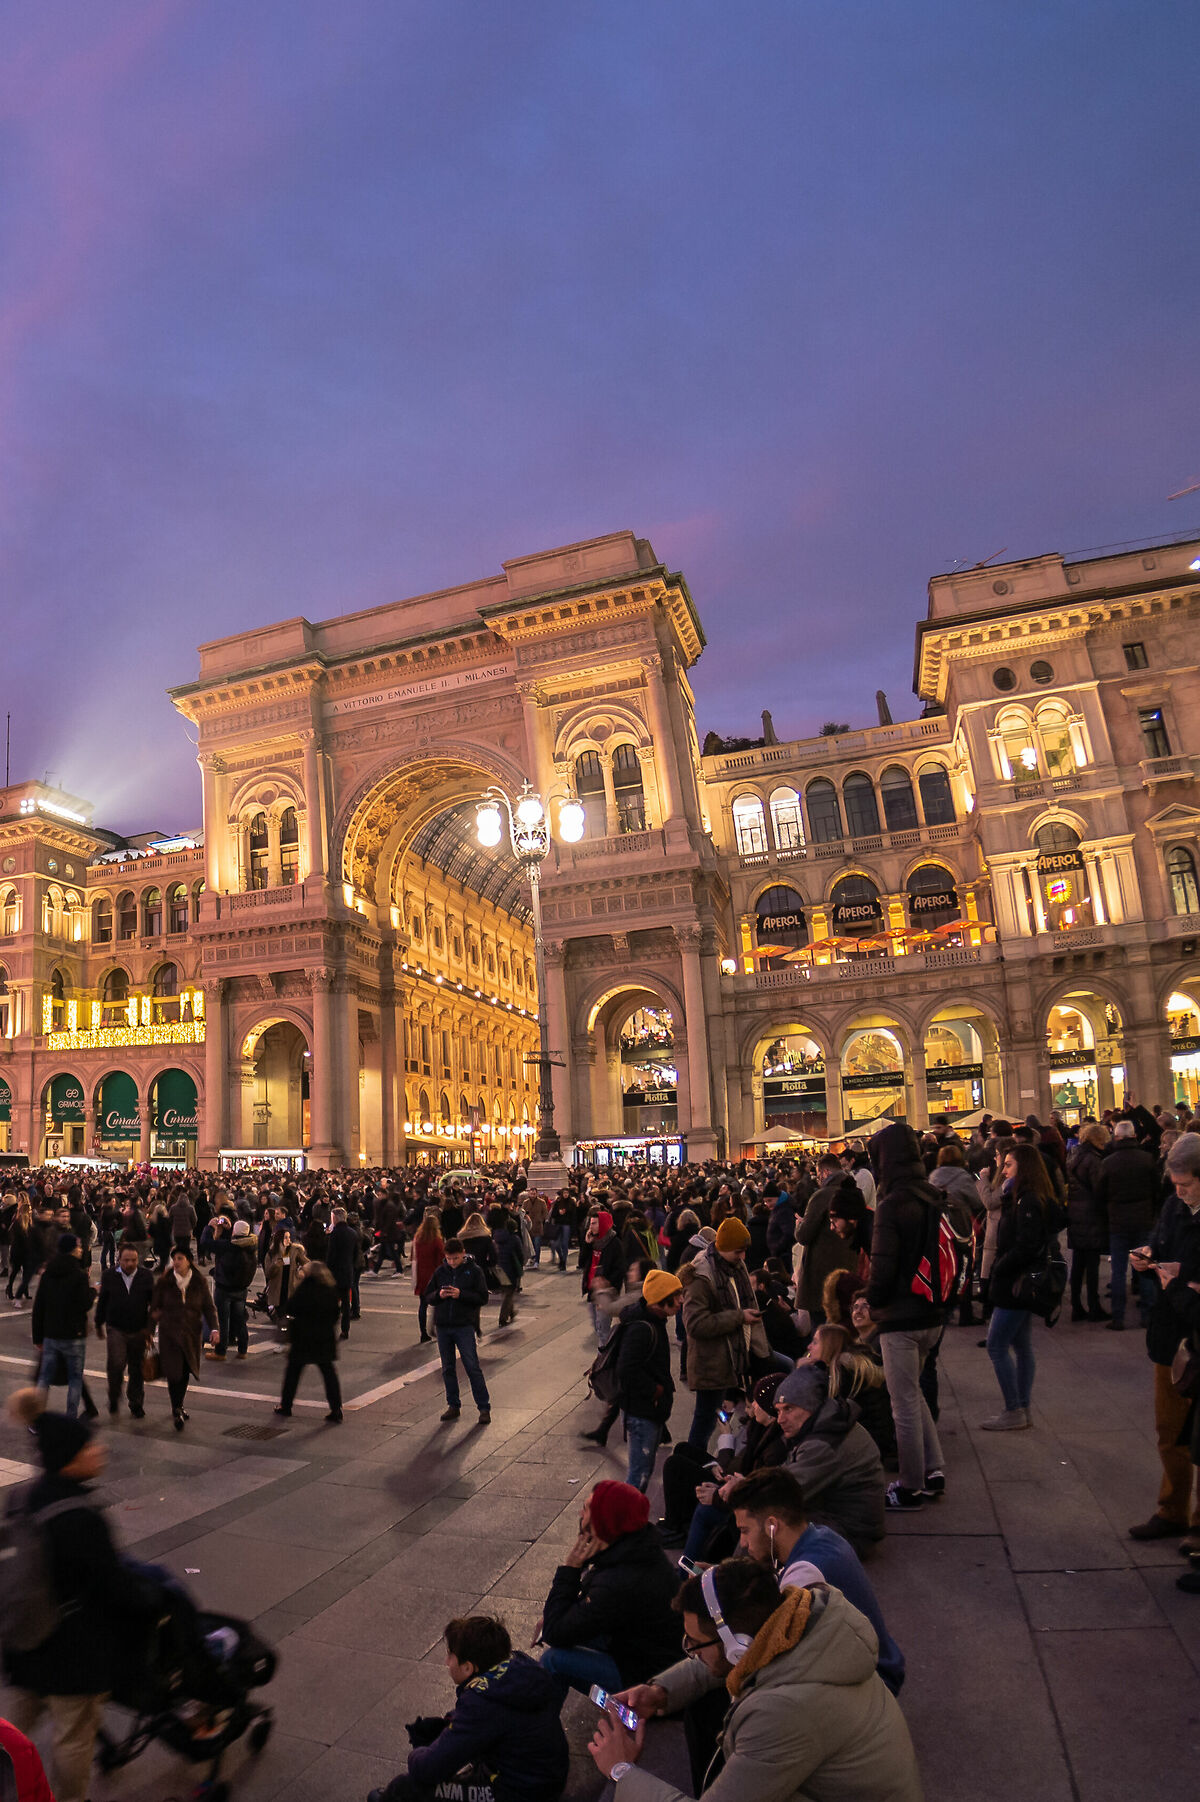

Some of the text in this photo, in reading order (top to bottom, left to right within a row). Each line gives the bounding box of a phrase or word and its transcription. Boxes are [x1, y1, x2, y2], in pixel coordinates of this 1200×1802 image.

[333, 704, 339, 712] A
[343, 695, 384, 709] VITTORIO
[388, 683, 437, 699] EMANUELE
[465, 666, 508, 682] MILANESI
[1038, 853, 1080, 869] APEROL
[914, 894, 952, 909] APEROL
[838, 904, 876, 919] APEROL
[763, 915, 801, 929] APEROL
[782, 1081, 808, 1091] Motta
[644, 1092, 669, 1103] Motta
[434, 1781, 464, 1802] WAY
